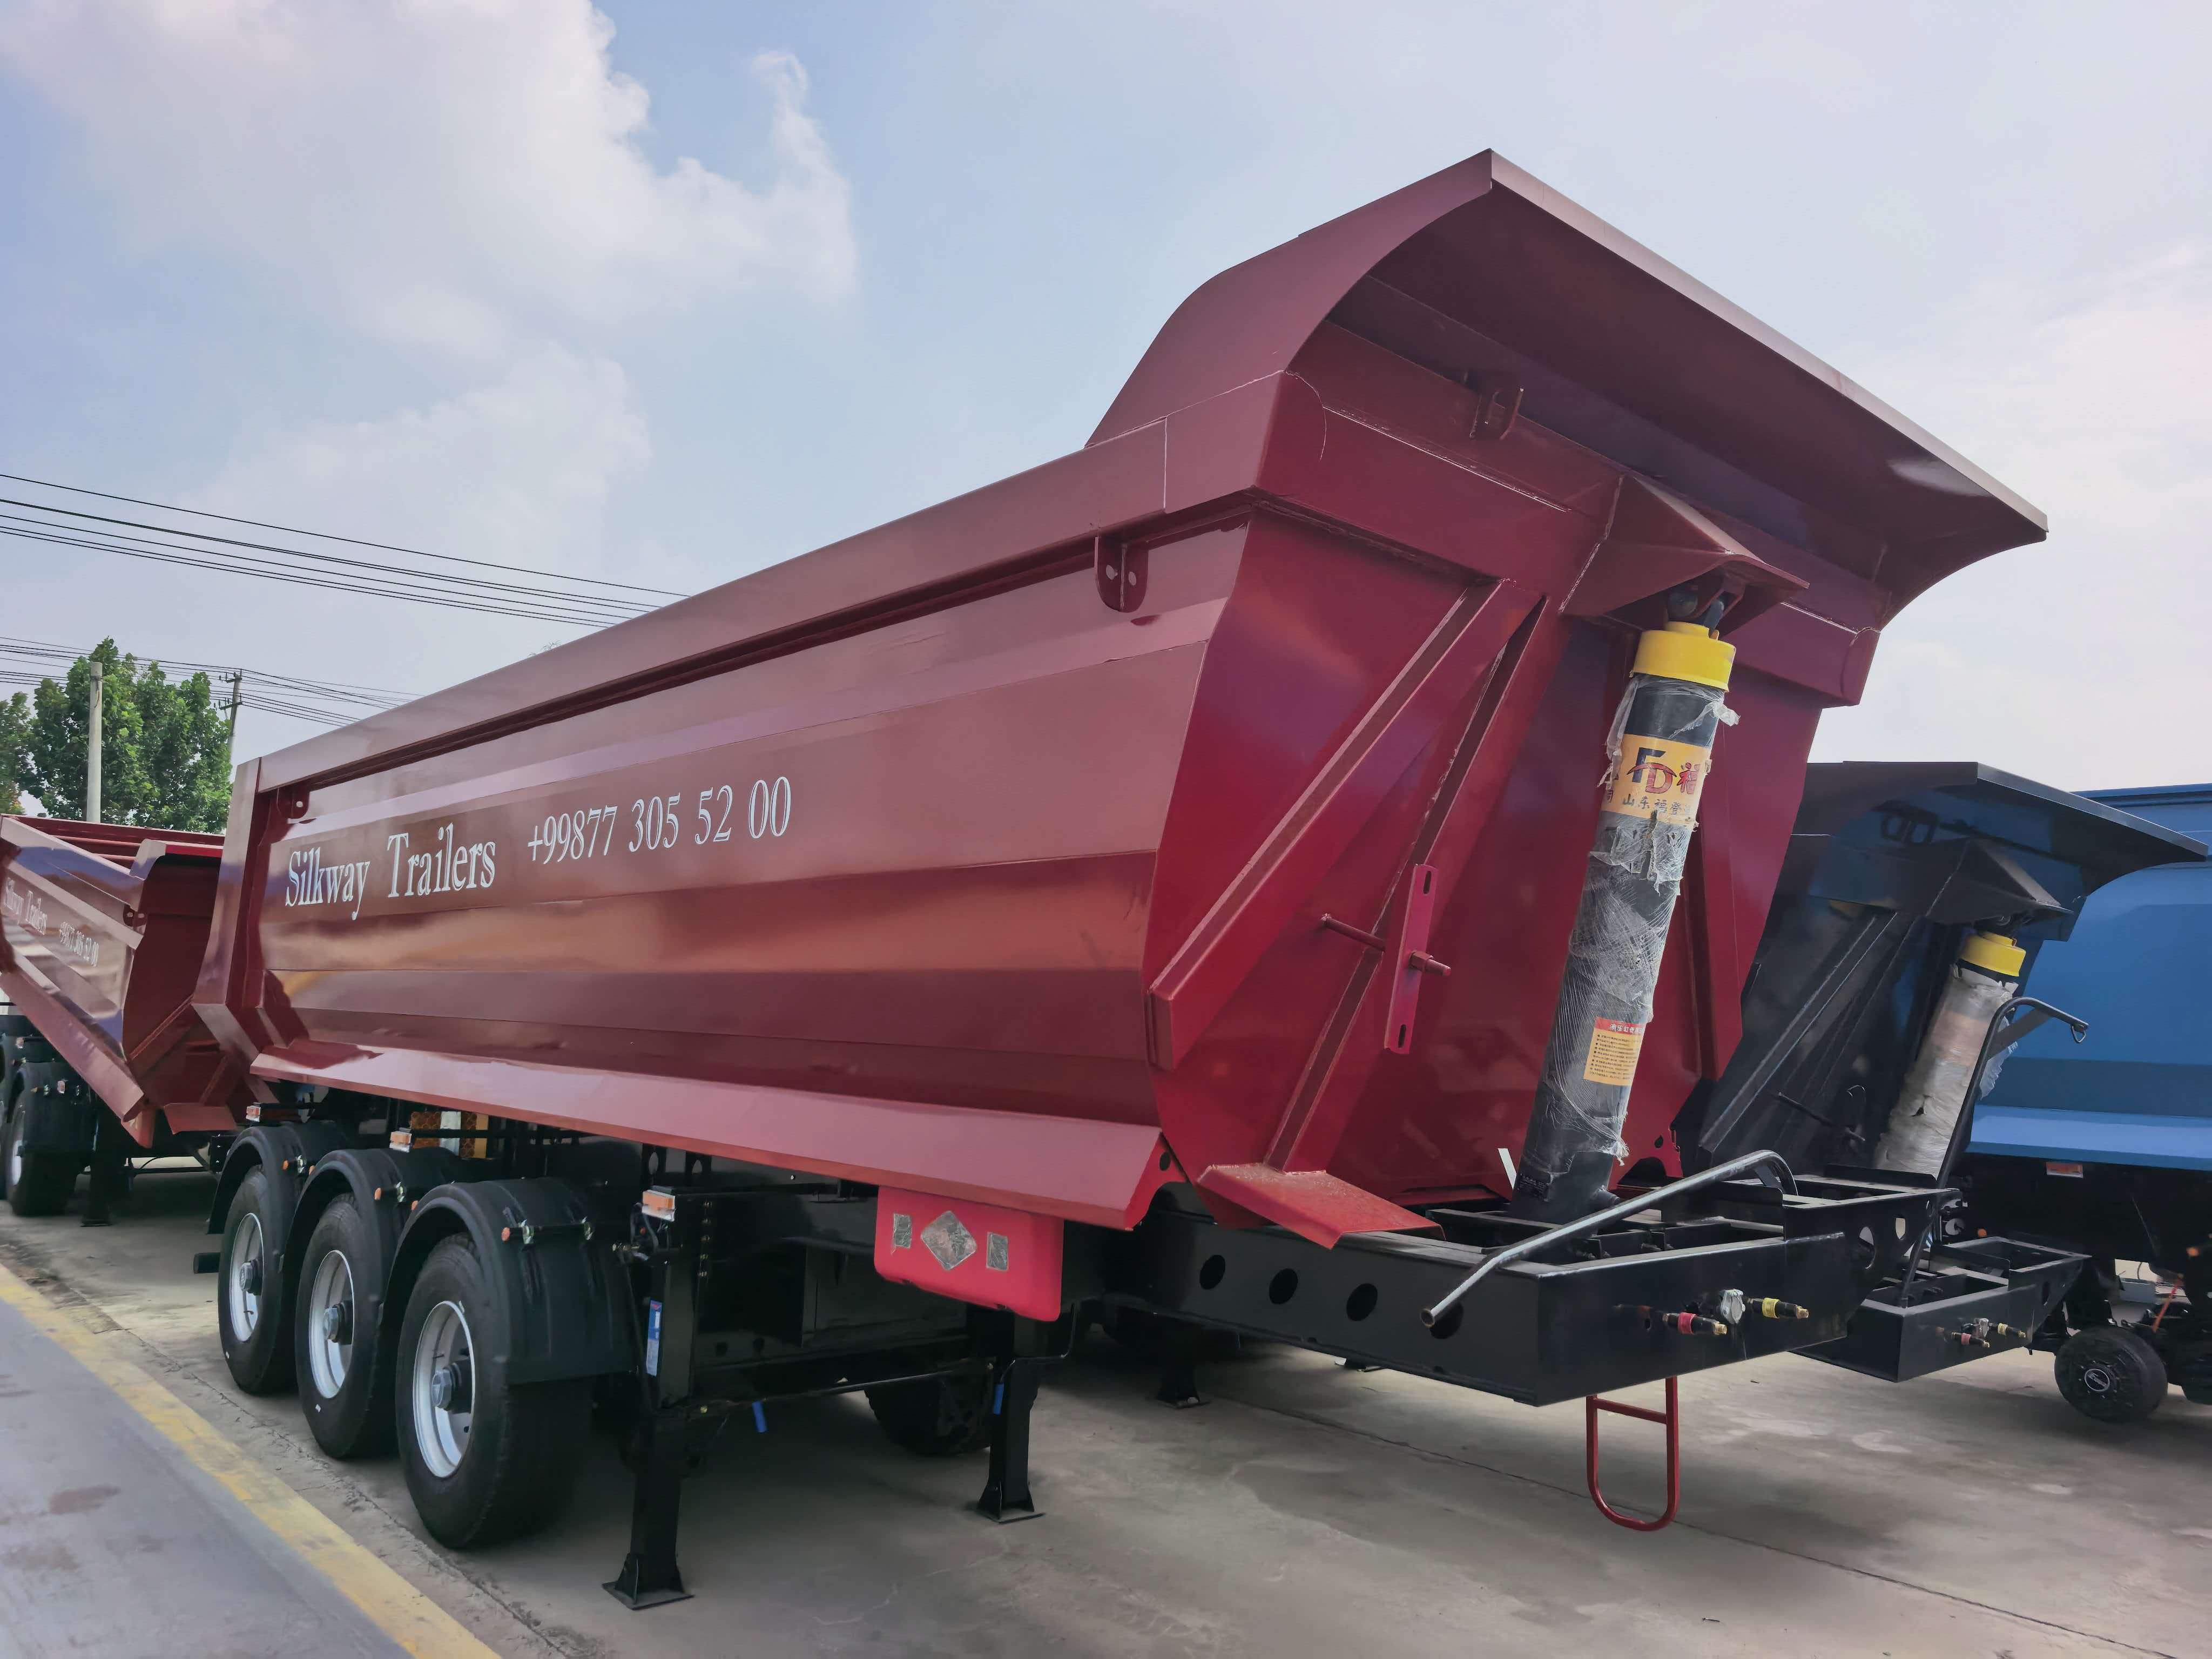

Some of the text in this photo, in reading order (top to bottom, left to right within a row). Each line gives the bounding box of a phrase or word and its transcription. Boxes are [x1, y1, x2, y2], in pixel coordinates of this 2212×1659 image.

[285, 776, 792, 921] Silkway Trailers +99877 305 52 00
